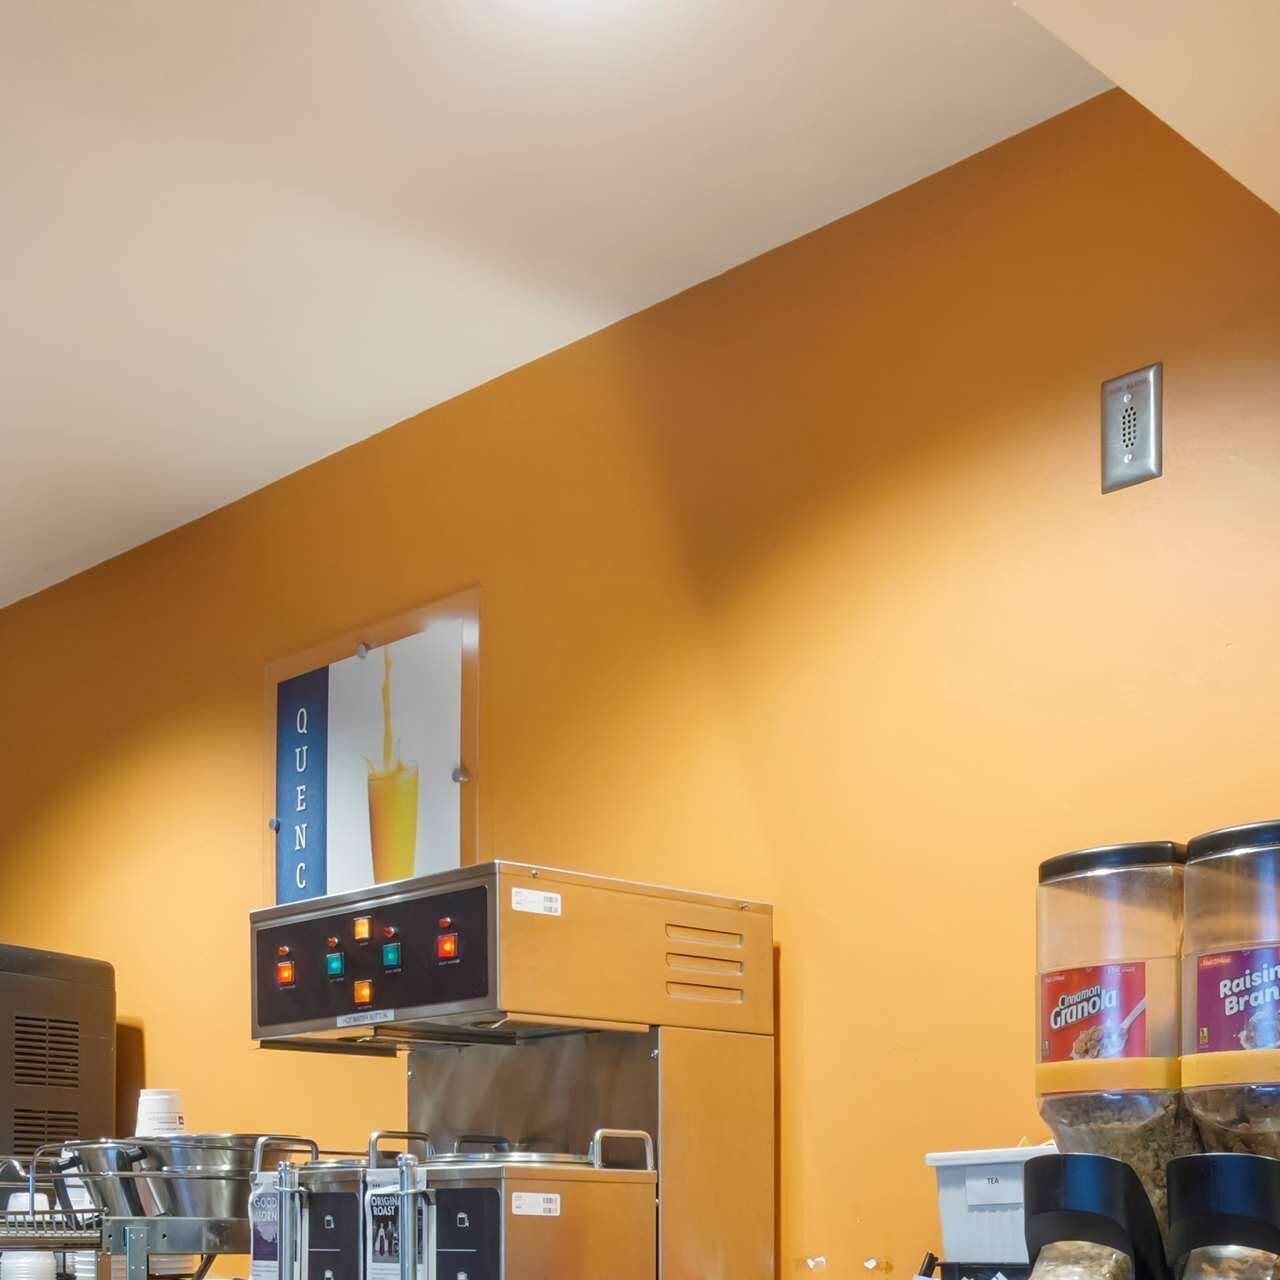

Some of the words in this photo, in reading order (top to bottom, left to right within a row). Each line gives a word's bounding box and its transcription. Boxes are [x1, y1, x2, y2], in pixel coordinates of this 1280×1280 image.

[1049, 989, 1118, 1030] Granola
[1058, 984, 1101, 1010] Cinnamon
[1224, 985, 1280, 1017] Bran
[372, 1206, 396, 1216] ROAST
